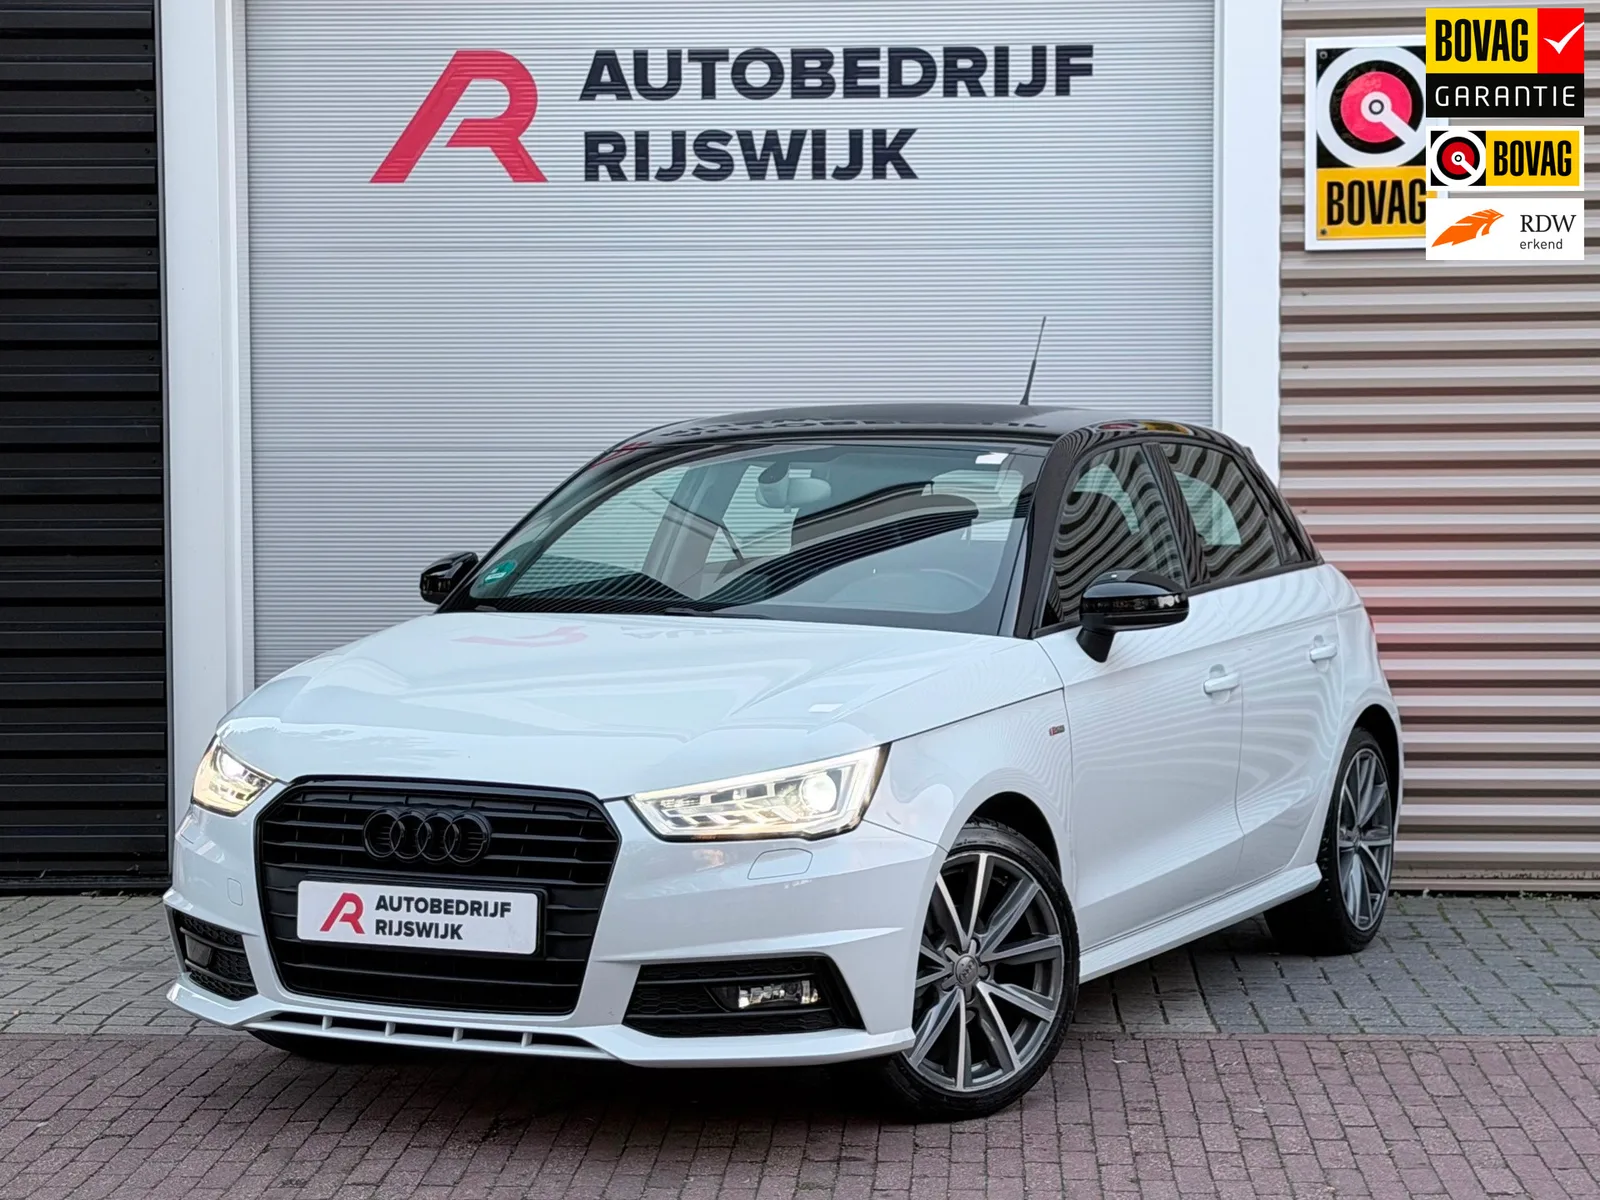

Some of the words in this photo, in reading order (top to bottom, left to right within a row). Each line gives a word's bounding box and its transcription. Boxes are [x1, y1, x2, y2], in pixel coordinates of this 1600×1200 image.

[579, 44, 1094, 101] AUTOBEDRIJF
[583, 128, 918, 182] RIJSWIJK
[1326, 178, 1426, 226] BOVAG
[375, 895, 511, 918] AUTOBEDRIJF
[375, 919, 463, 940] RIJSWIJK
